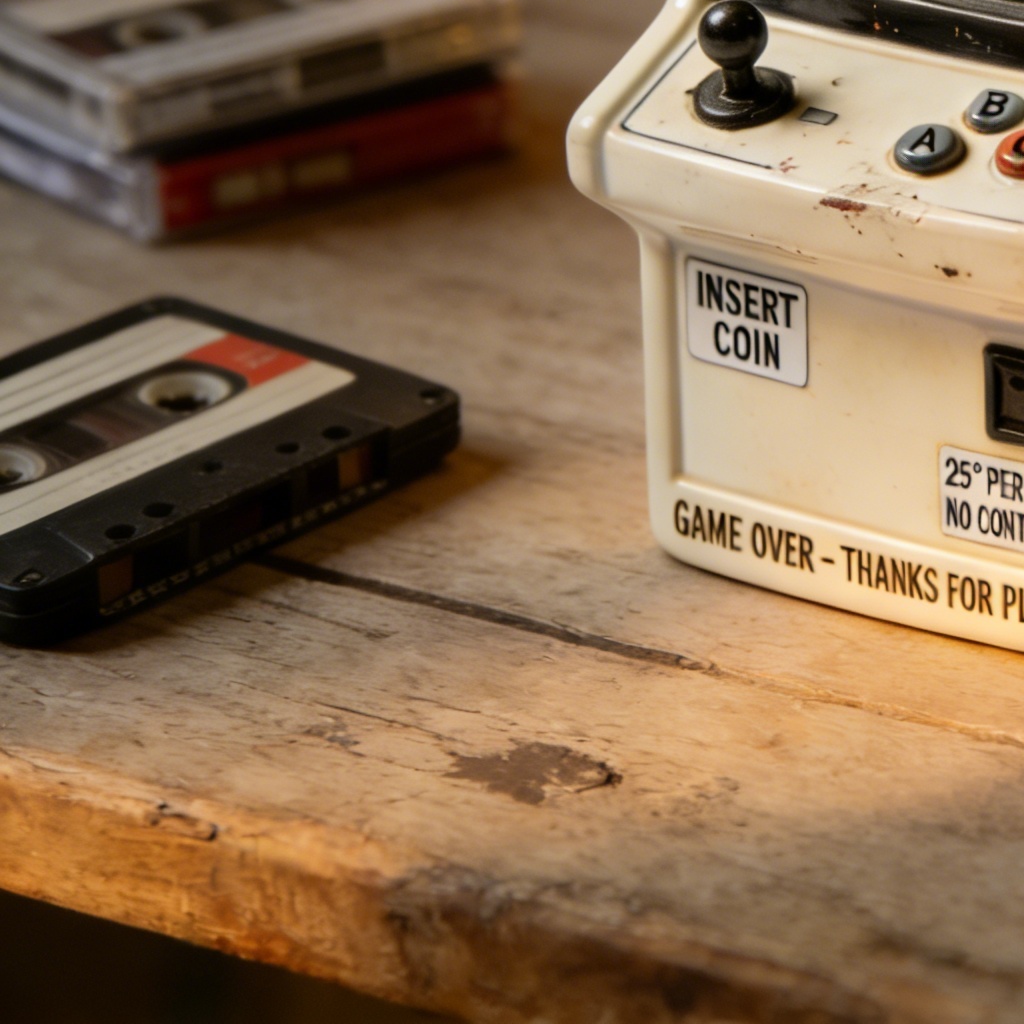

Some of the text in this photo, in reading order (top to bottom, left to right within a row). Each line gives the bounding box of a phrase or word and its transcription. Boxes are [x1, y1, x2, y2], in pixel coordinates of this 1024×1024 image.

[979, 91, 1009, 117] B
[909, 127, 936, 153] A
[697, 271, 799, 328] INSERT
[714, 321, 780, 370] COIN
[987, 467, 1023, 502] PER
[946, 496, 971, 530] NO
[674, 499, 743, 552] GAME
[752, 522, 815, 573] OVER
[840, 545, 939, 603] THANKS
[947, 572, 993, 616] FOR
